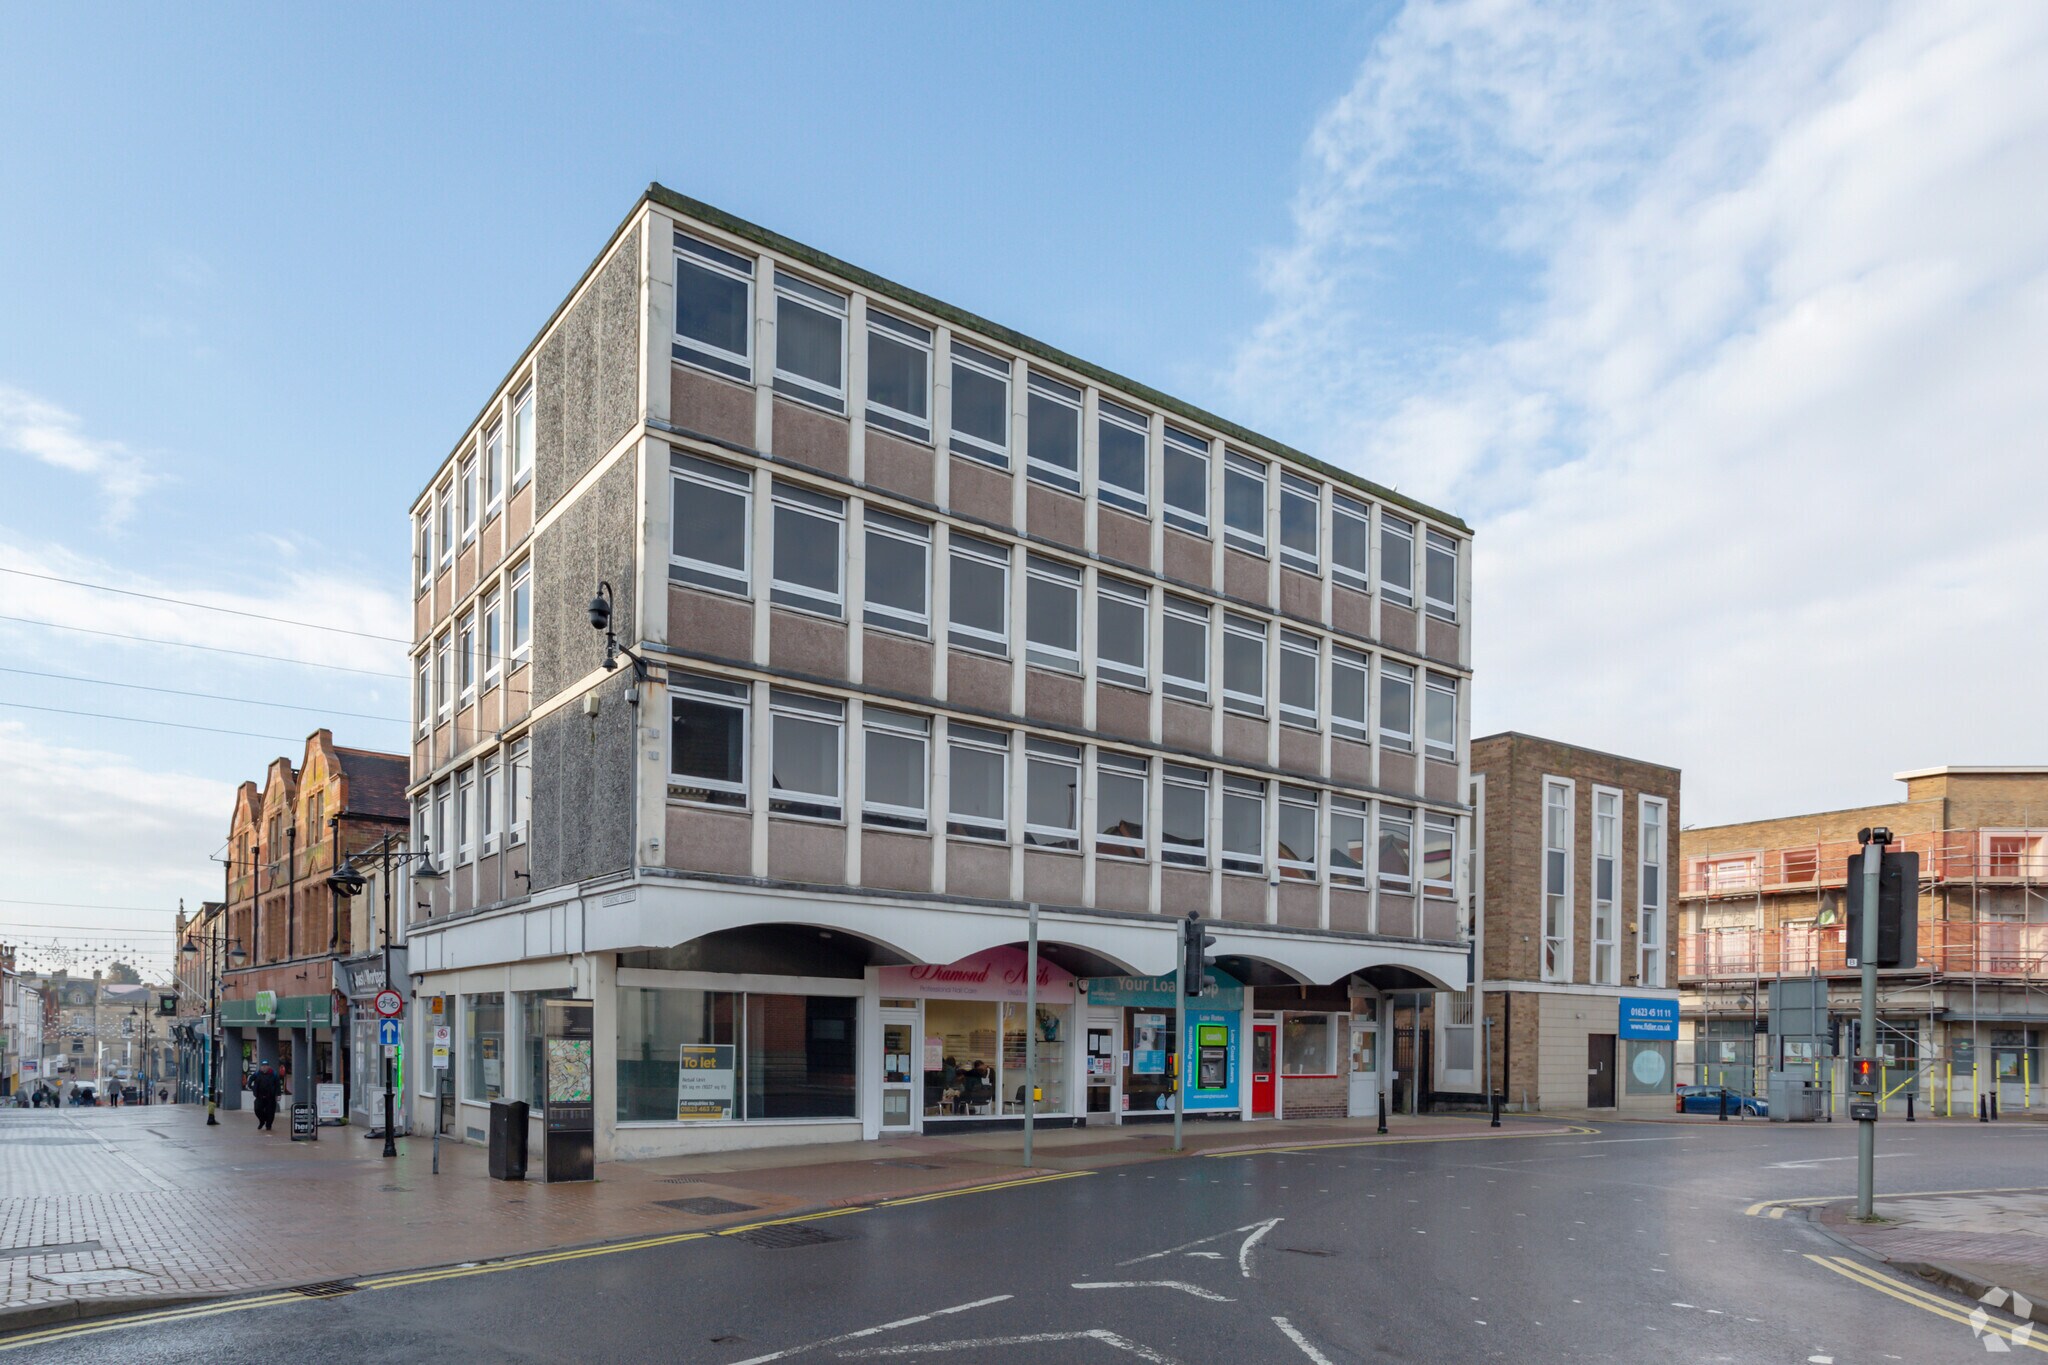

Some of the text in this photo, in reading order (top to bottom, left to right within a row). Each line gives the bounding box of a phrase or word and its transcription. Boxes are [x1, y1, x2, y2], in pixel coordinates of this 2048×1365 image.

[910, 963, 1050, 986] Diamond Nils
[1118, 977, 1149, 992] Your
[1153, 979, 1176, 993] Loa
[1630, 1007, 1671, 1018] 01623 45 11 11
[683, 1056, 716, 1068] To let
